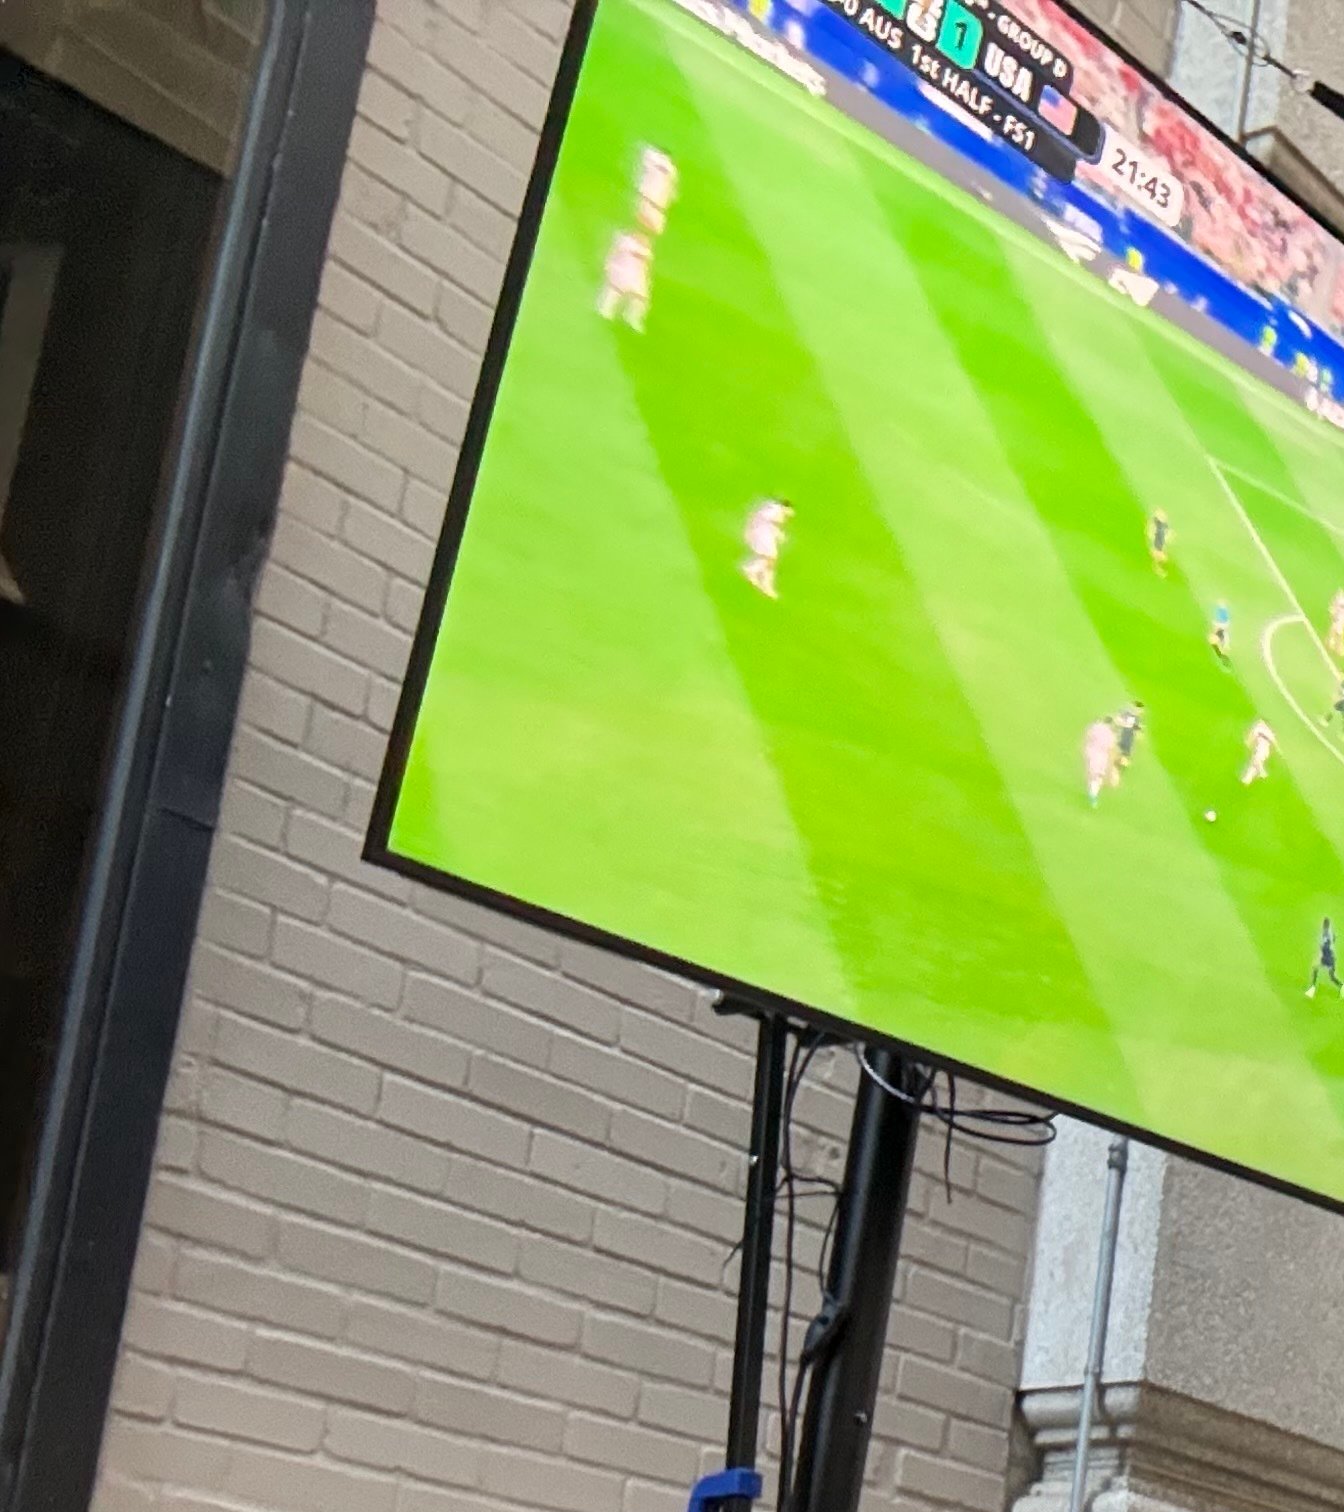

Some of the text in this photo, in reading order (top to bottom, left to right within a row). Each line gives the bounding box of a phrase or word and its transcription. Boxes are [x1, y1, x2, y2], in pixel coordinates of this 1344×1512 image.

[858, 7, 904, 49] AUS
[954, 21, 968, 51] 1
[997, 14, 1054, 66] GROUP
[1052, 57, 1068, 78] D
[983, 41, 1034, 103] USA
[941, 67, 994, 115] HALF
[1002, 114, 1036, 152] FS1
[1111, 147, 1171, 209] 21:43
